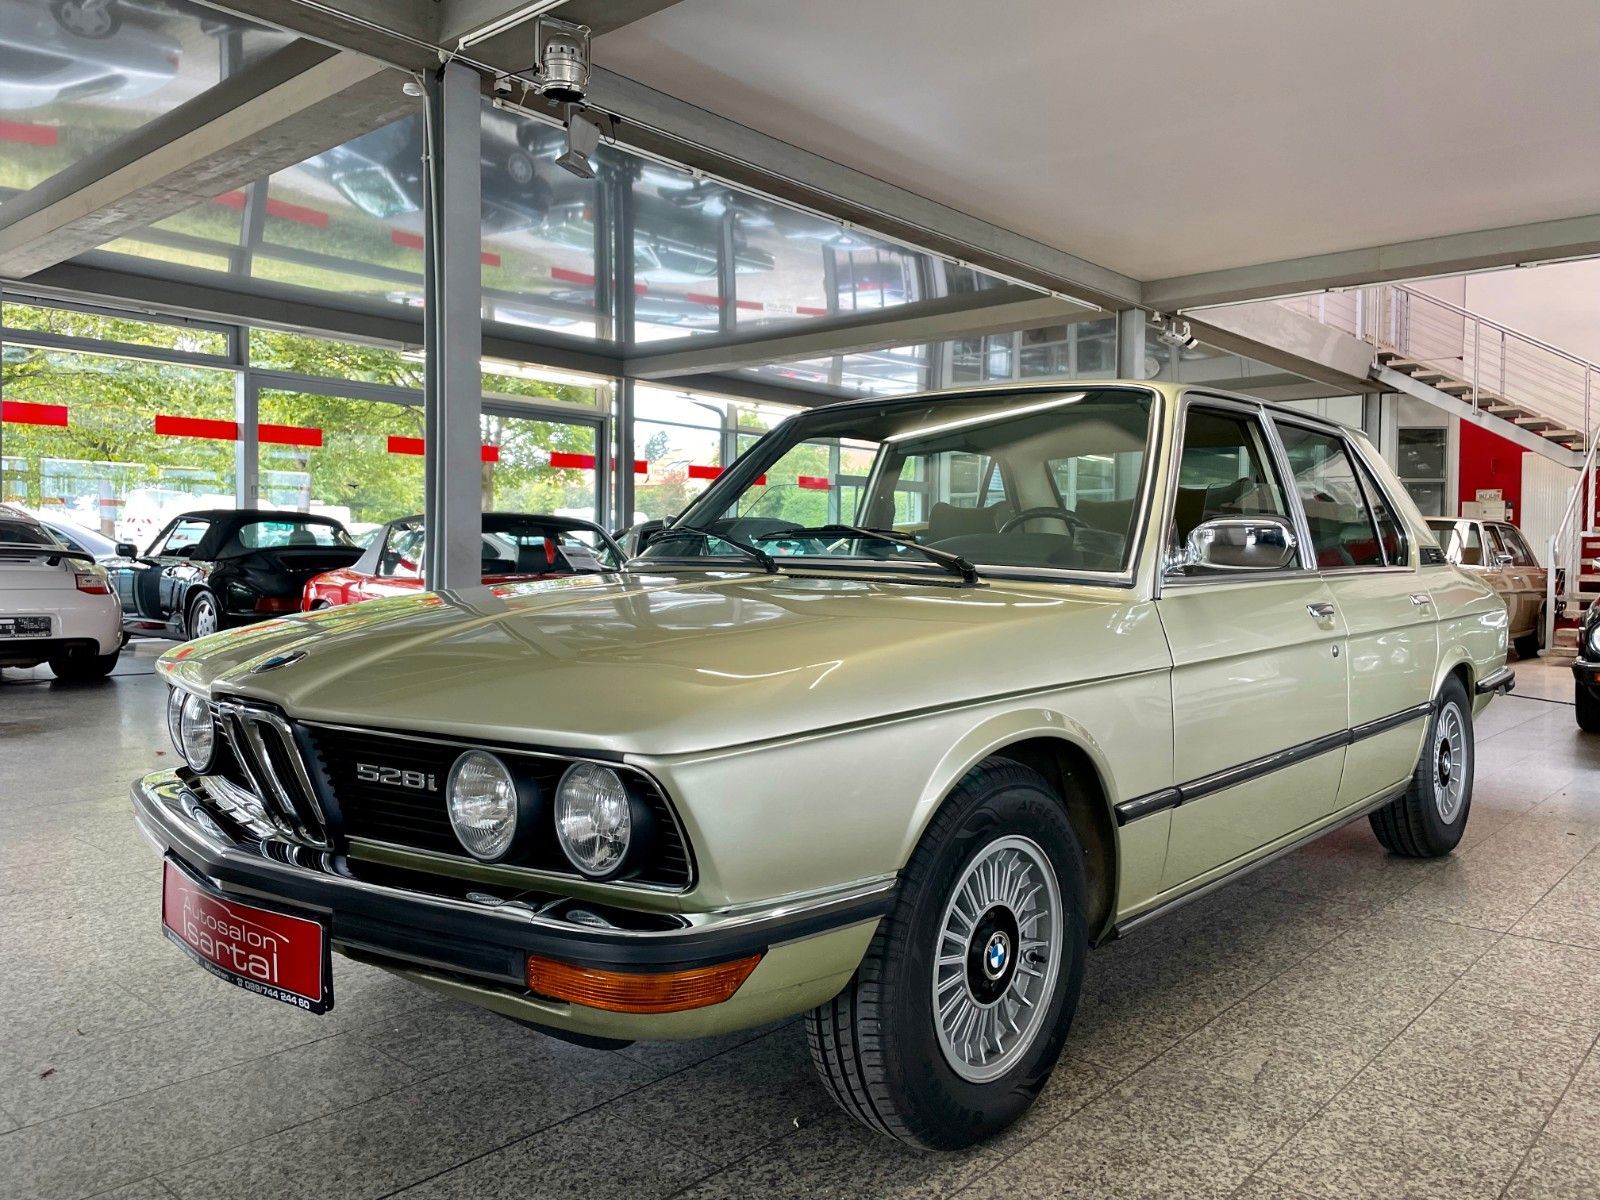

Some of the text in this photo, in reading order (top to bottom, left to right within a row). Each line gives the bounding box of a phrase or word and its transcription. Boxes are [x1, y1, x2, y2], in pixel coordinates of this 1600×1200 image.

[357, 763, 438, 792] 528i
[183, 895, 278, 953] Autosalon
[183, 909, 279, 983] Isartal
